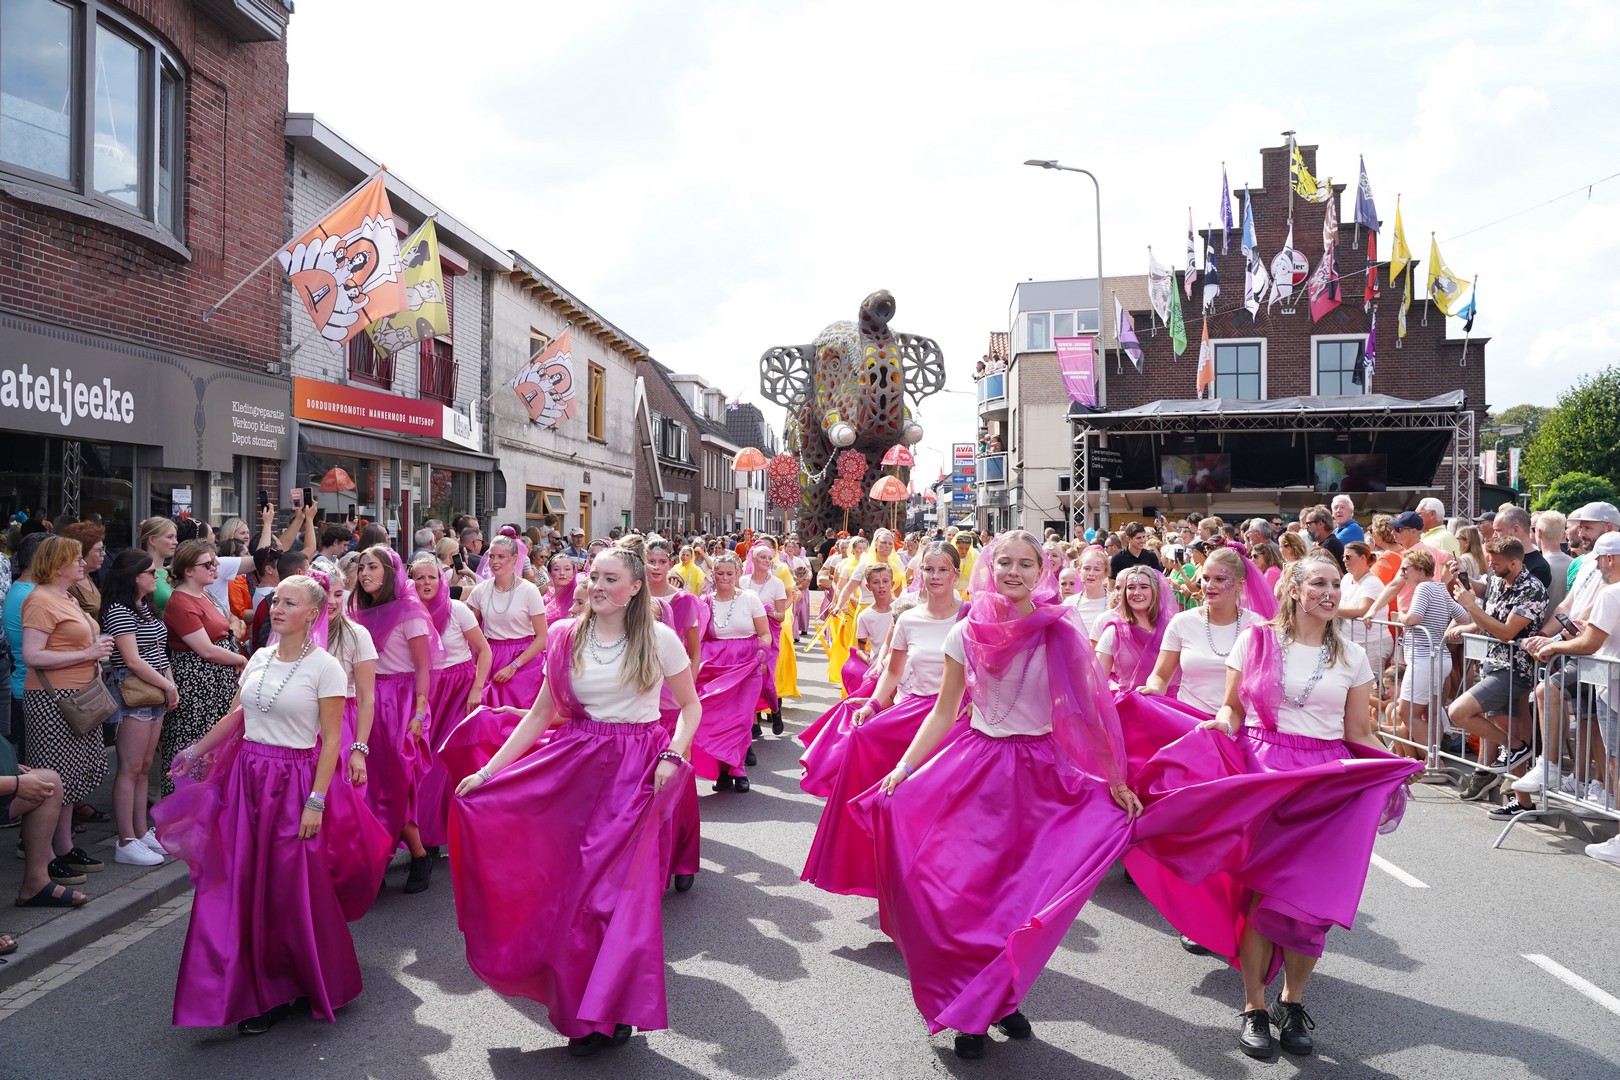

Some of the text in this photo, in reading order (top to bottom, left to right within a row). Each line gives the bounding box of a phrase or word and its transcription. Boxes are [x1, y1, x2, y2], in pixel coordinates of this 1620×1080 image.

[0, 363, 134, 426] ateljeeke
[232, 400, 284, 420] Kledingreparatie
[306, 398, 434, 427] BORDUURPROMOTIE MANNENMODE DARTSHOP
[232, 416, 286, 434] Verkoop kleinvak
[232, 432, 278, 450] Depot stomerij
